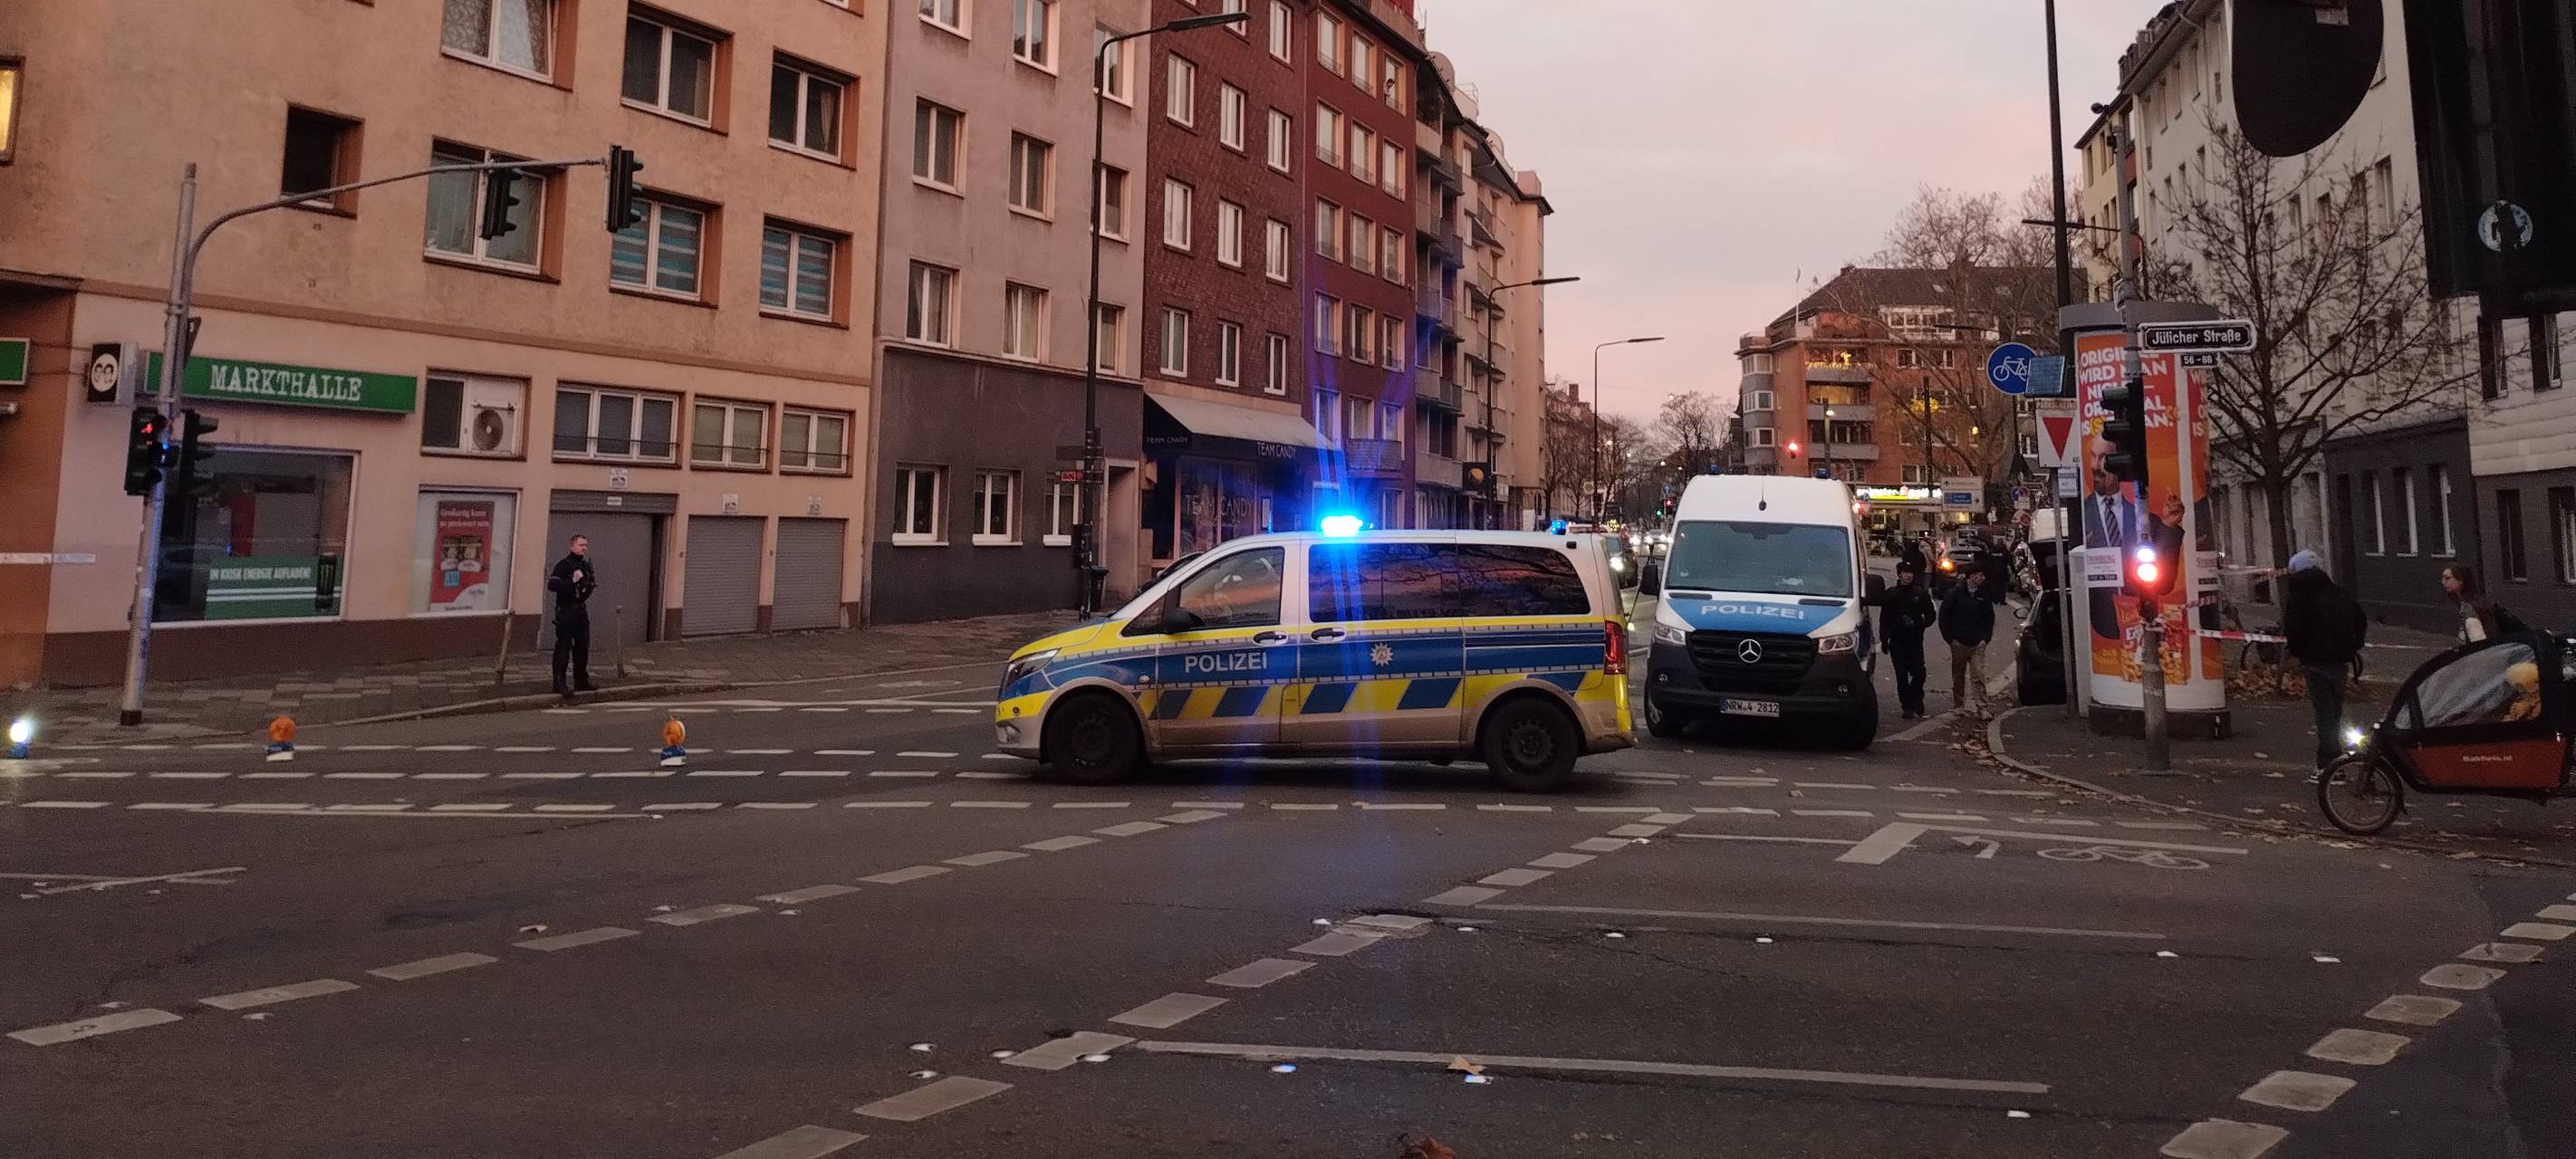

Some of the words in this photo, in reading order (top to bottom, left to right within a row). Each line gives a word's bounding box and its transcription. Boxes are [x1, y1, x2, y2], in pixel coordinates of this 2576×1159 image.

[2152, 330, 2199, 344] Jülicher
[2203, 328, 2242, 343] Straße
[209, 364, 363, 401] MARKTHALLE
[2080, 364, 2116, 384] WIRD
[1166, 436, 1188, 444] CANDY
[1257, 441, 1275, 456] TEAM
[1276, 444, 1296, 459] CANDY
[1186, 493, 1215, 515] TEAM
[1220, 496, 1254, 516] CANDY
[1701, 605, 1804, 619] POLIZEI
[1185, 652, 1267, 673] POLIZEI
